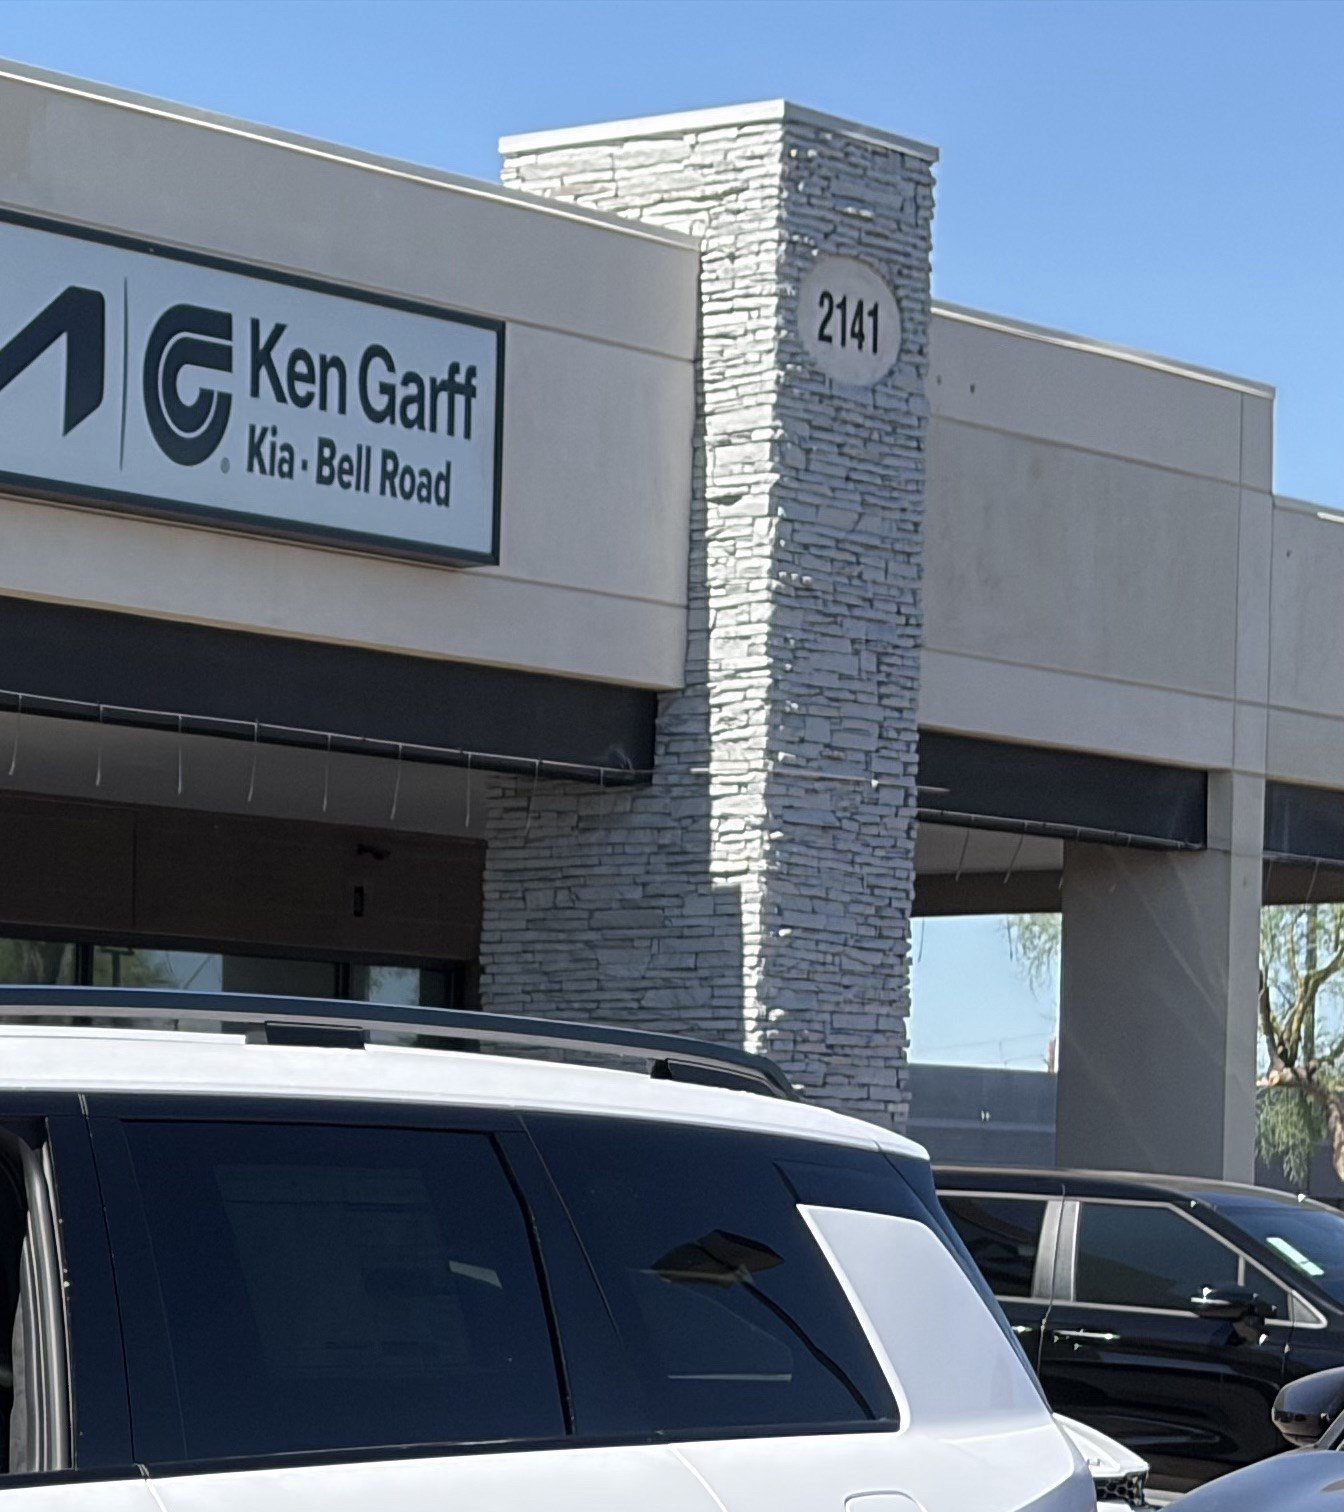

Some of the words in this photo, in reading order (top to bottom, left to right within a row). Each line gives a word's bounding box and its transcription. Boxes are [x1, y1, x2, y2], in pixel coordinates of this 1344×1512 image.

[817, 290, 880, 355] 2141
[249, 317, 347, 415] Ken
[358, 344, 477, 440] Garff
[247, 423, 294, 480] Kia
[315, 437, 371, 493] Bell
[379, 448, 452, 507] Road
